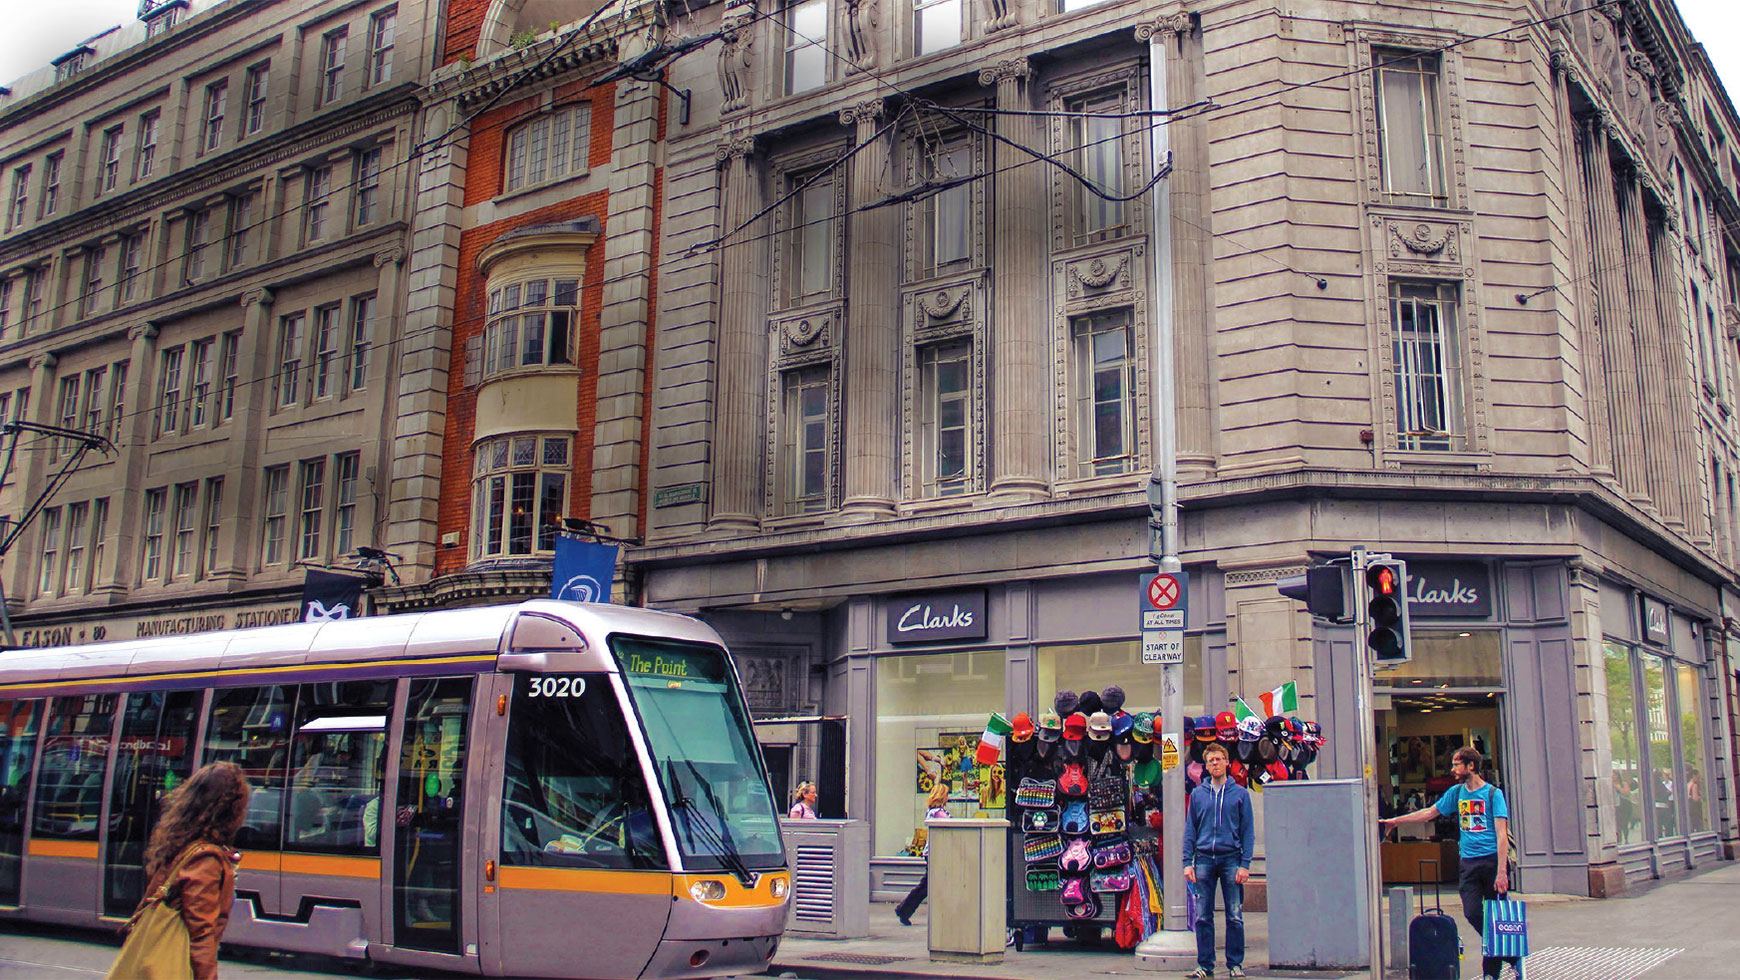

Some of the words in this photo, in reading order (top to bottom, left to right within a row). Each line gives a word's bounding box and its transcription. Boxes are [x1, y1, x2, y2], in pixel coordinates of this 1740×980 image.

[136, 614, 226, 638] MANUFACTURING
[897, 604, 974, 632] Clarks
[22, 627, 73, 648] EASON
[1145, 643, 1168, 651] START
[1170, 642, 1180, 650] OF
[629, 654, 651, 674] The
[653, 656, 688, 677] Point
[1143, 652, 1182, 661] CLEARWAY
[528, 677, 587, 698] 3020
